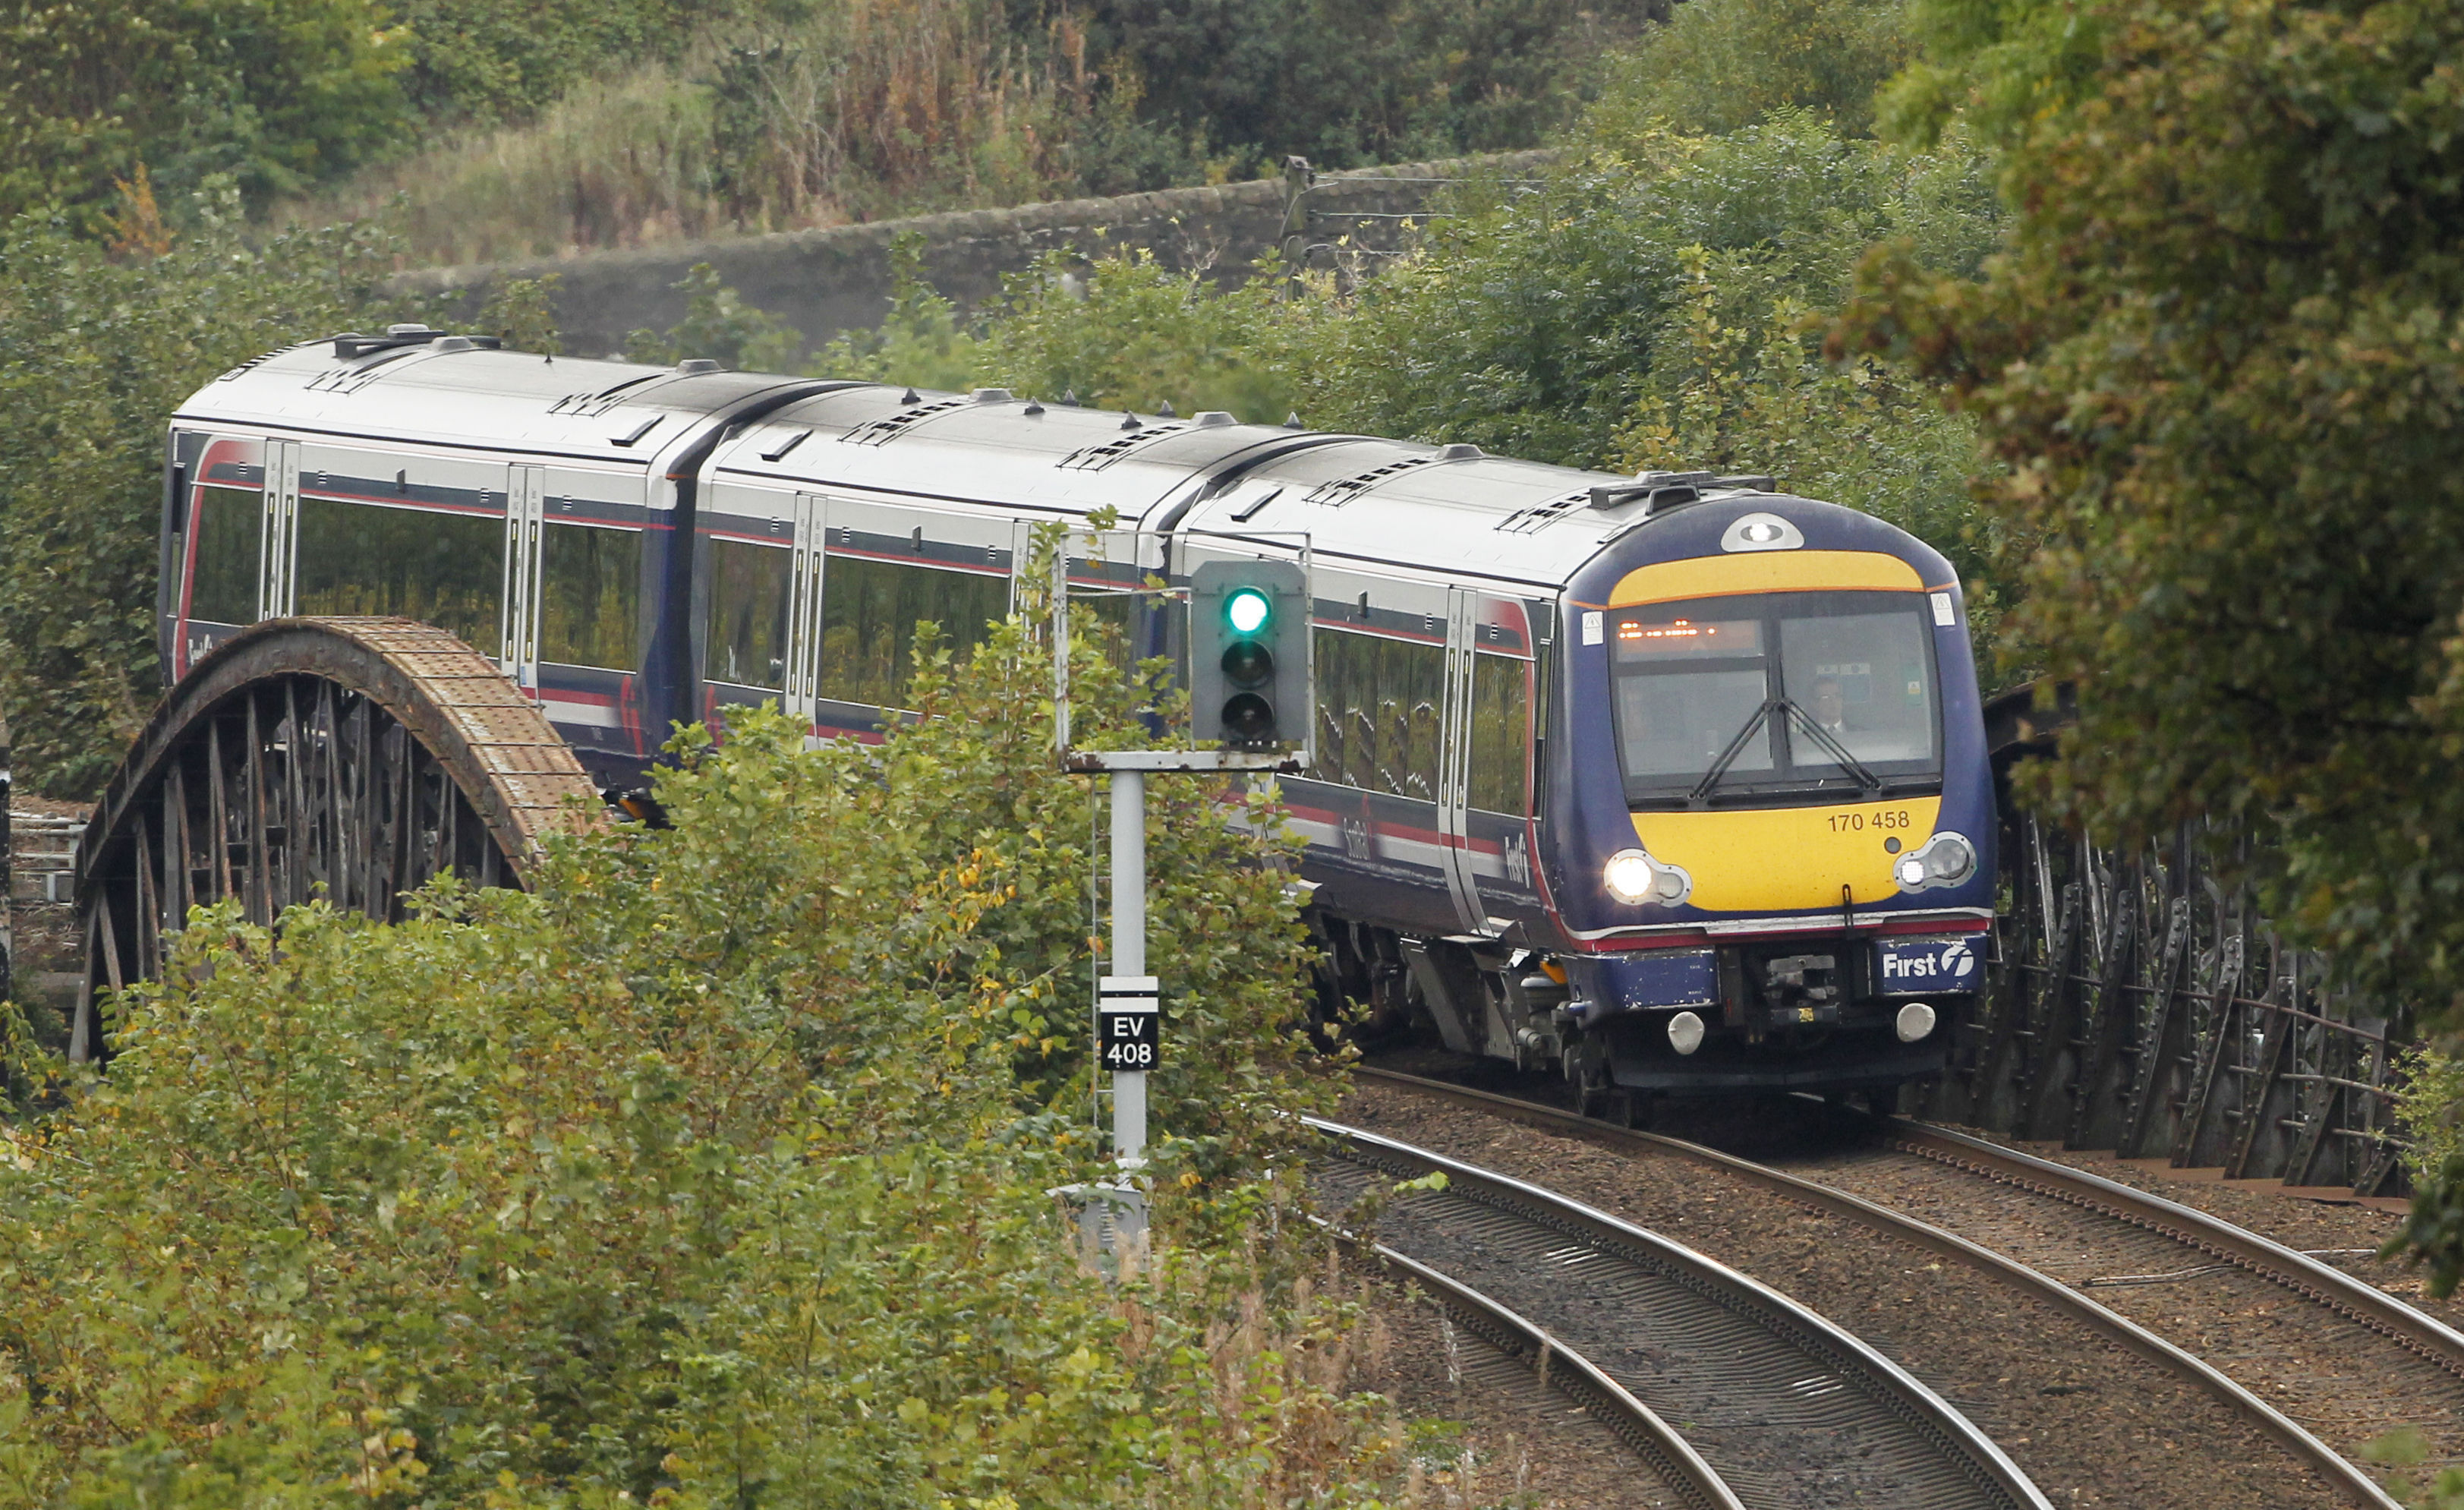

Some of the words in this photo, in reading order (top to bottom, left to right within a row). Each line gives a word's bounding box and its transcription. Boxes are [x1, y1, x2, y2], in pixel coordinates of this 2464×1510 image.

[1828, 813, 1864, 832] 170
[1871, 810, 1910, 829] 458
[1883, 952, 1936, 978] First
[1114, 1017, 1145, 1037] EV
[1107, 1042, 1152, 1064] 408
